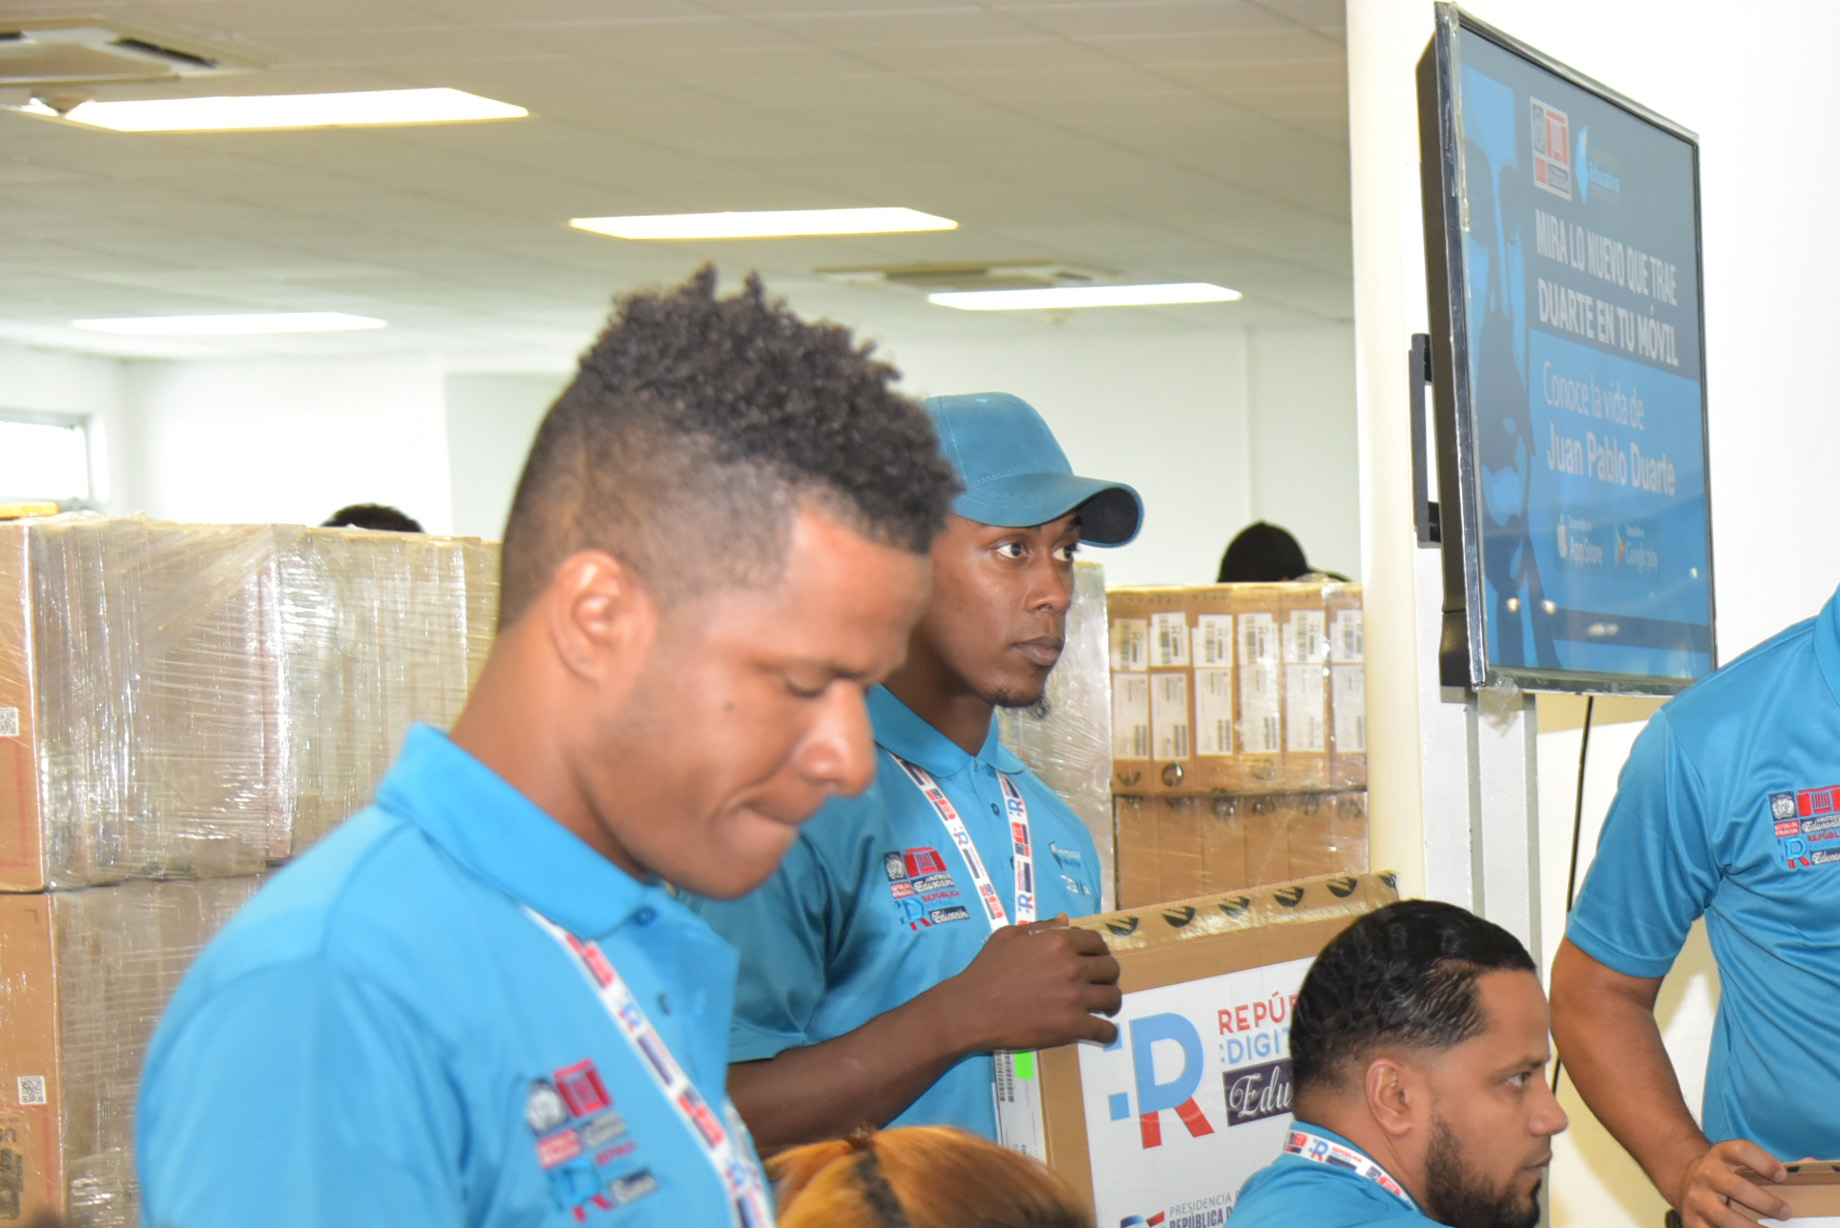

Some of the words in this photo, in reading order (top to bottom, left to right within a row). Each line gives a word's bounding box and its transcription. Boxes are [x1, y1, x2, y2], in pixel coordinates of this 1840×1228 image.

[1535, 208, 1569, 265] MIRA
[1569, 222, 1586, 272] LO
[1587, 230, 1625, 287] NUEVO
[1627, 246, 1649, 296] QUE
[1650, 255, 1678, 306] TRAE
[1538, 277, 1595, 339] DUARTE
[1596, 299, 1616, 346] EN
[1616, 306, 1635, 353] TU
[1636, 304, 1679, 367] MÓVIL
[1543, 360, 1589, 416] Conoce
[1591, 372, 1602, 419] la
[1602, 380, 1628, 426] vida
[1630, 385, 1645, 431] de
[1547, 421, 1584, 476] Juan
[1587, 431, 1627, 487] Pablo
[1630, 442, 1676, 497] Duarte
[1169, 1191, 1232, 1217] PRESIDENCIA
